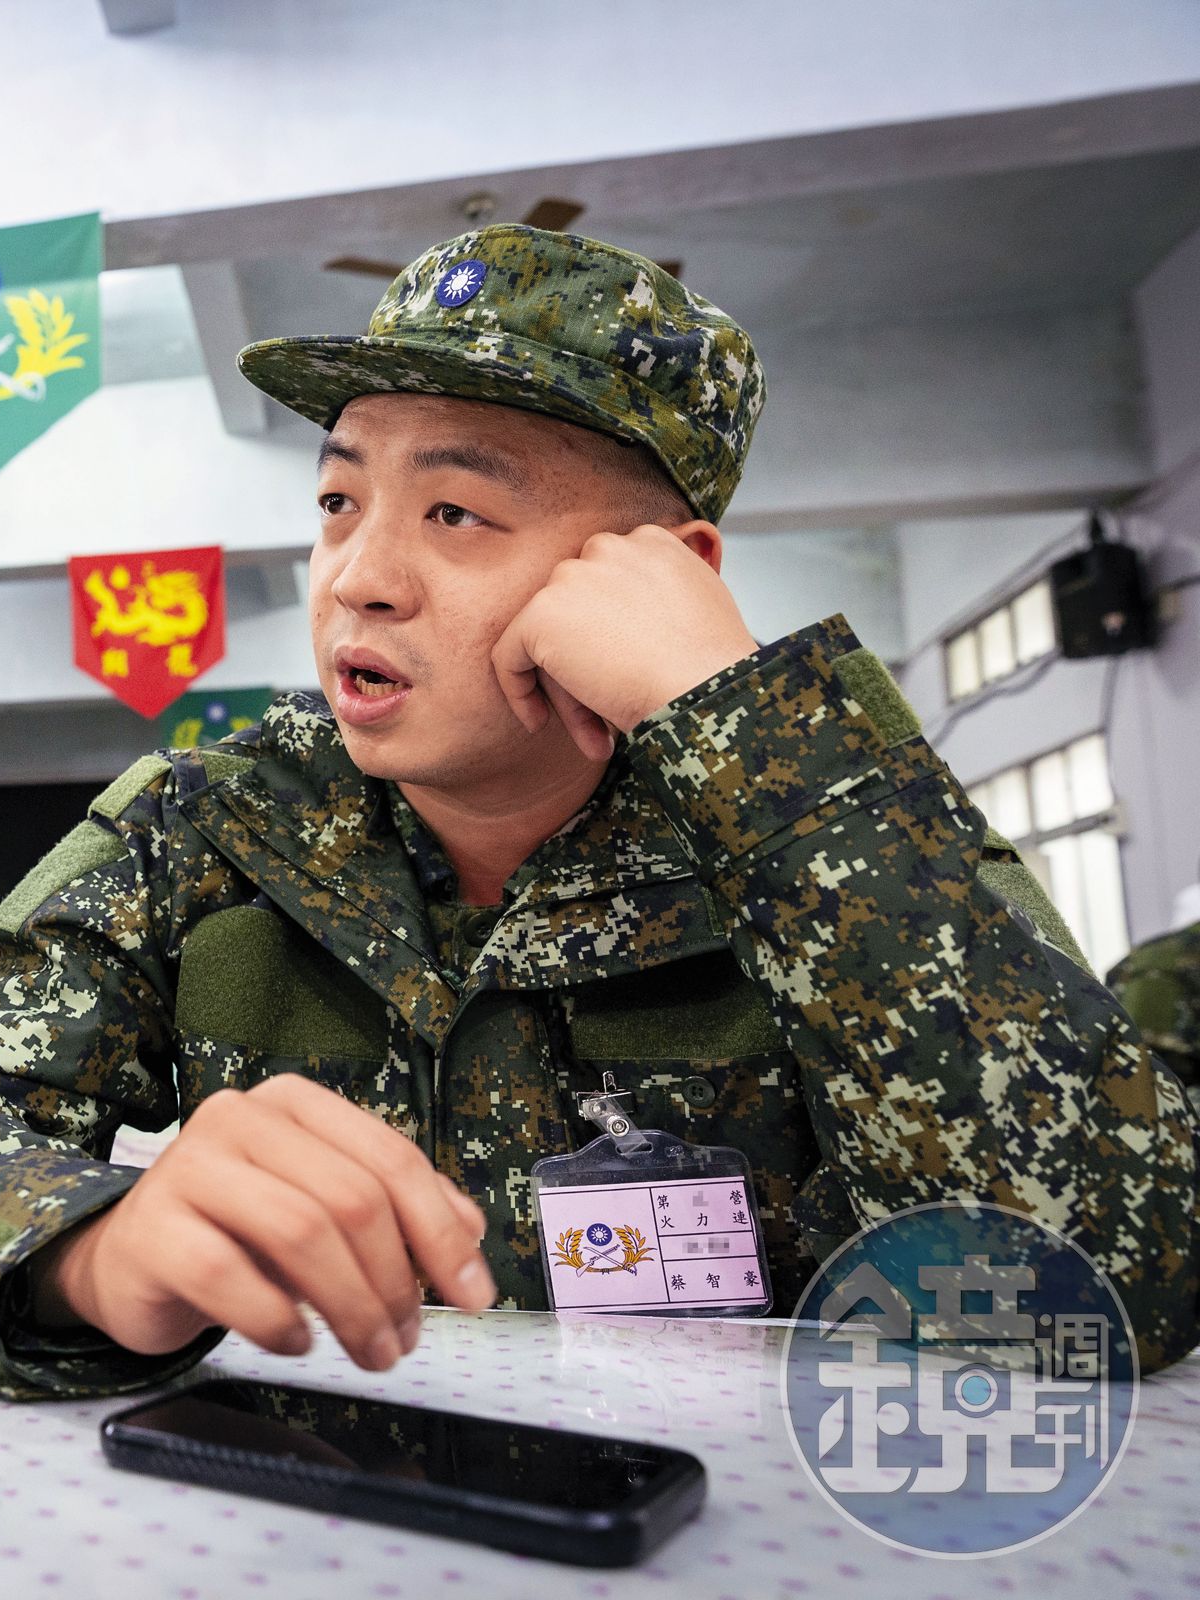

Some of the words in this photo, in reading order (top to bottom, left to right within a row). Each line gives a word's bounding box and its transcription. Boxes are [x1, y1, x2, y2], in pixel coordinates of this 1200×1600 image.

[661, 1210, 749, 1229] 火力連
[671, 1270, 760, 1290] 蔡智豪
